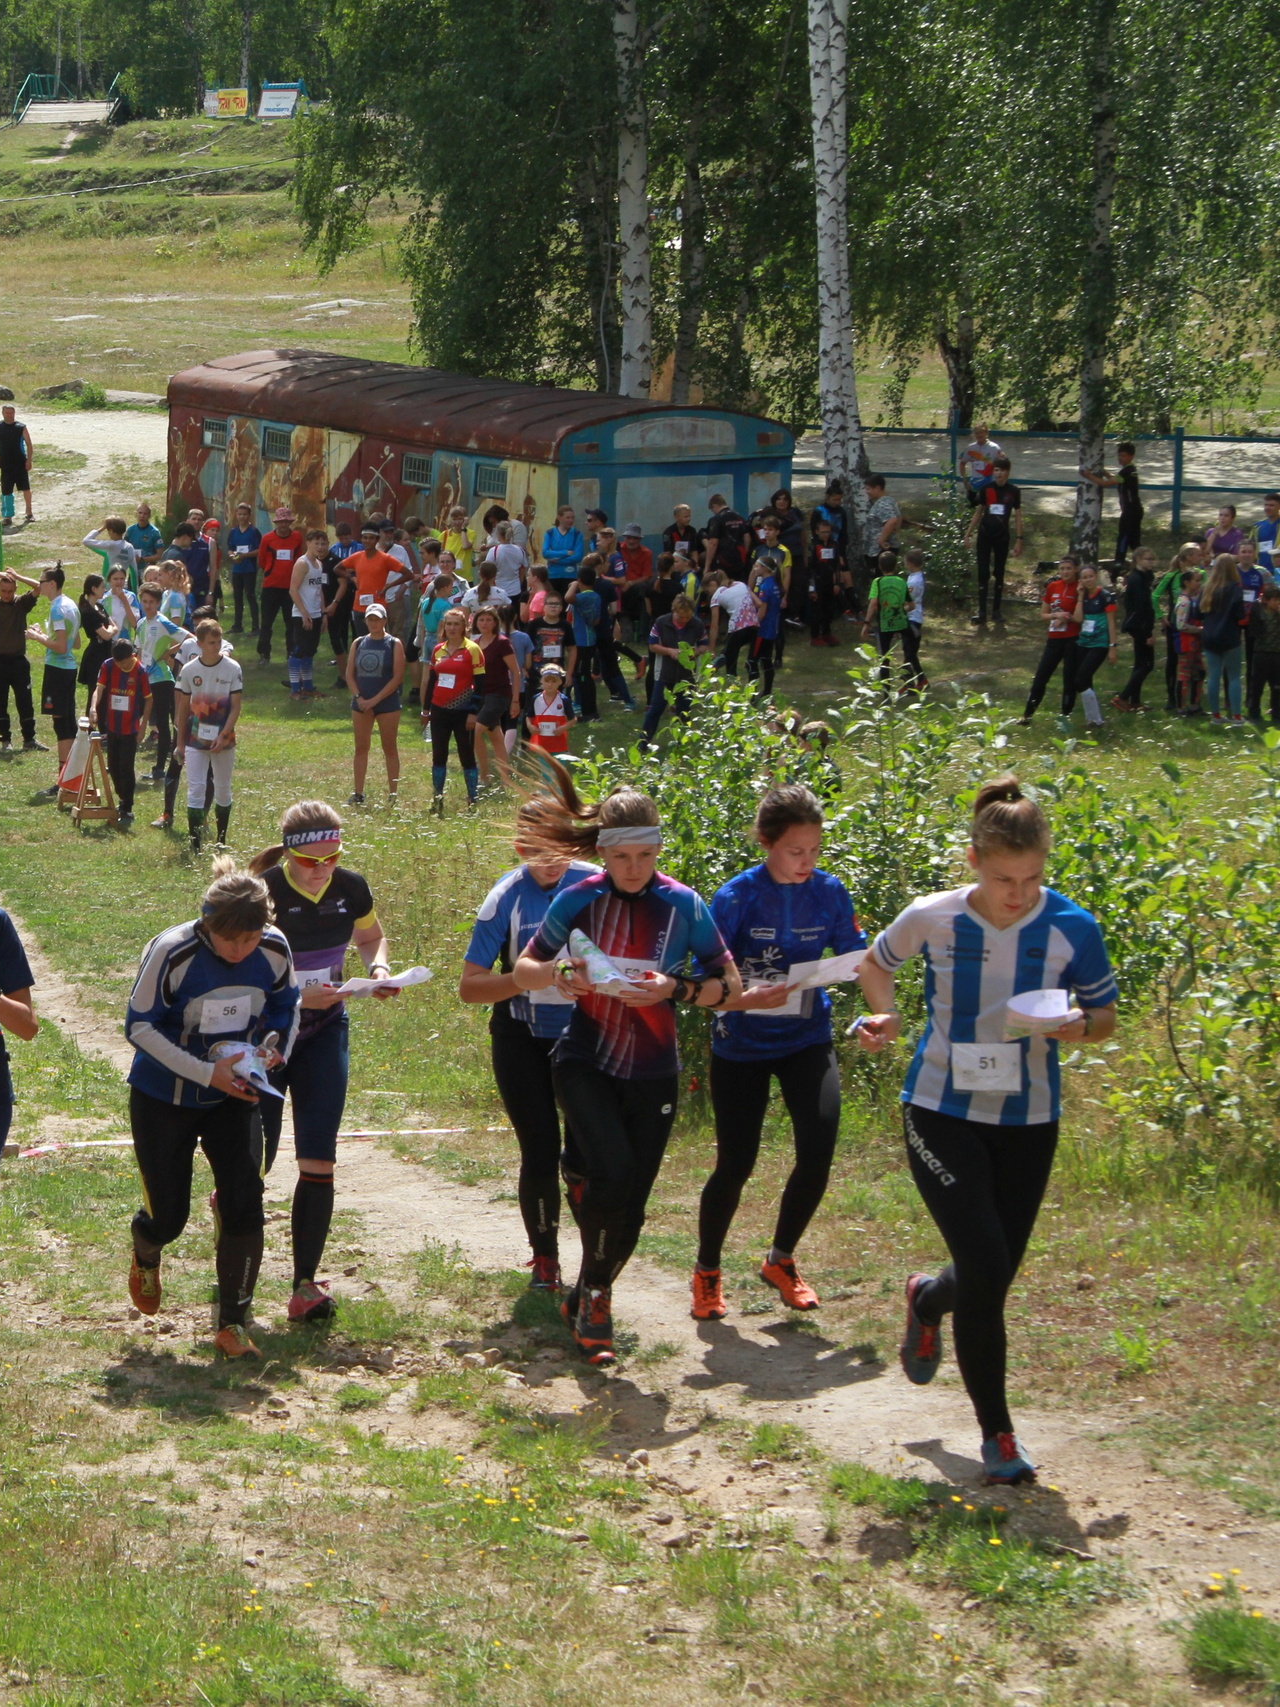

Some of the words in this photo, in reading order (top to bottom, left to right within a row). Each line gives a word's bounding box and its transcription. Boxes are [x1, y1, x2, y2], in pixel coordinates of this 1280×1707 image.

[305, 978, 319, 988] 62
[222, 1005, 237, 1016] 56
[979, 1056, 997, 1070] 51
[904, 1105, 957, 1187] bagheera
